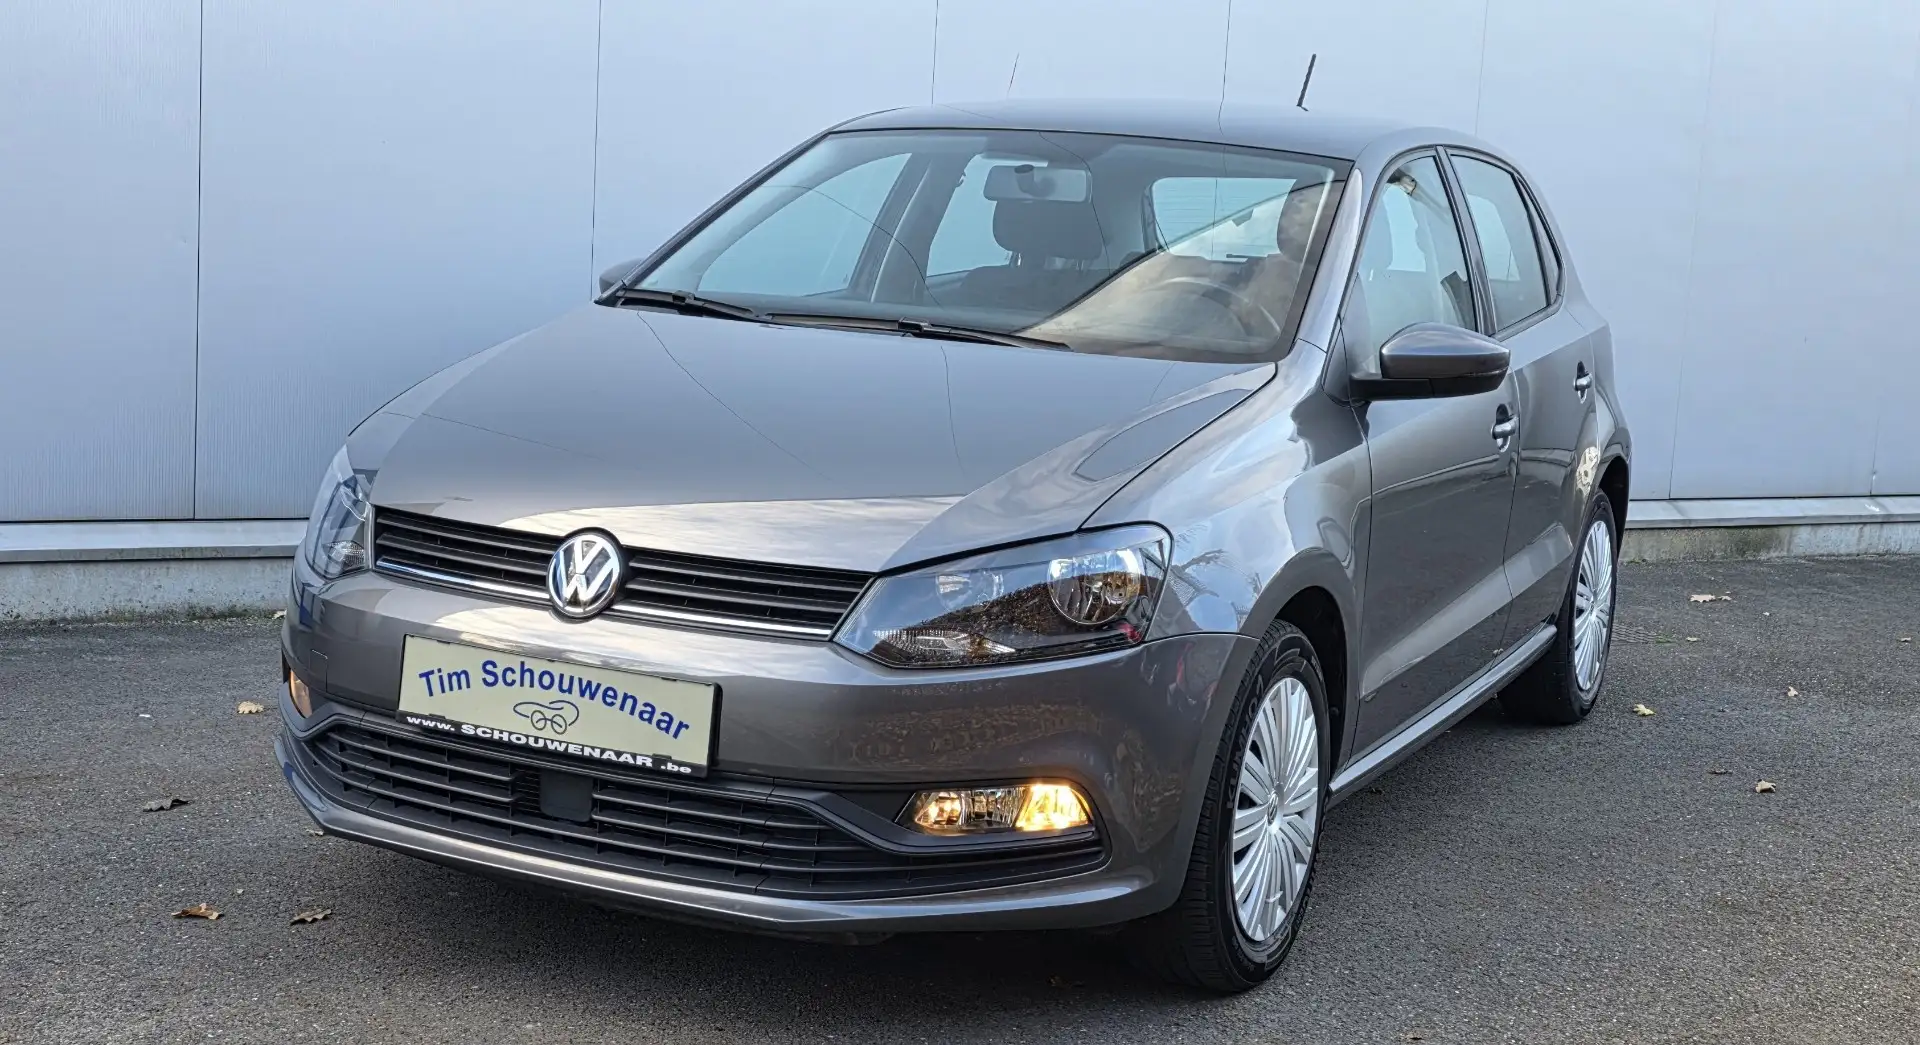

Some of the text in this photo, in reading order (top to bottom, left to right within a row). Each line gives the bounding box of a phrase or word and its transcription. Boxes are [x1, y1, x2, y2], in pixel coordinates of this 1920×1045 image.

[548, 533, 620, 614] VW
[418, 659, 690, 740] Tim Schouwenaar
[406, 716, 692, 774] www. SCHOUWENAAR .be
